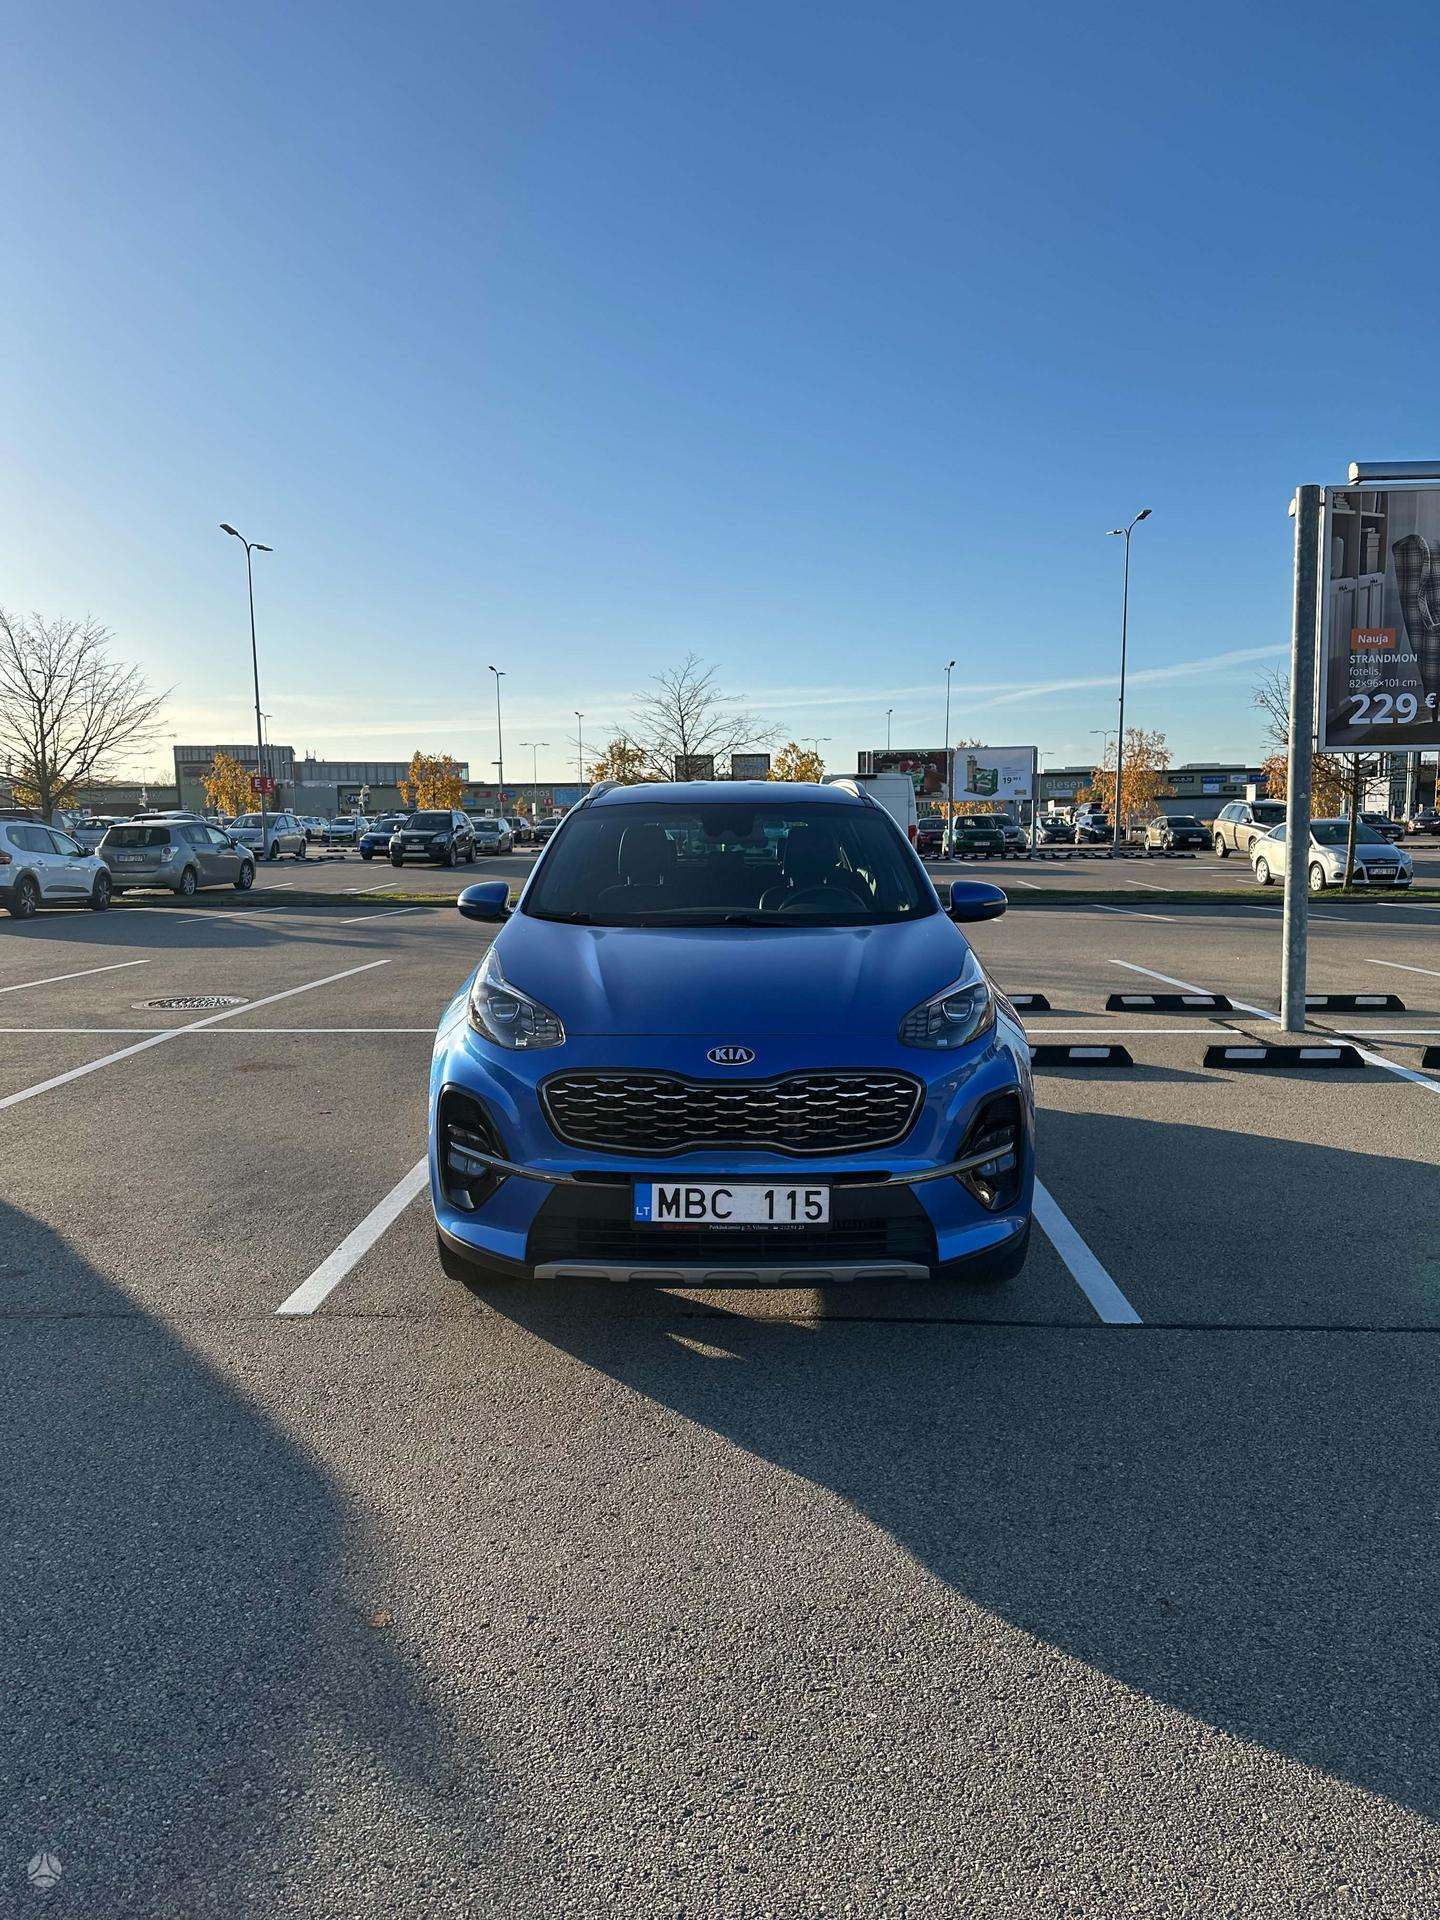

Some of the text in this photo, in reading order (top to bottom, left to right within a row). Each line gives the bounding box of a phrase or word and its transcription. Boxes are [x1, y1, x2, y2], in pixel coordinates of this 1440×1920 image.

[1357, 633, 1389, 645] Nauja
[1349, 653, 1418, 664] STRANDMON
[1349, 666, 1382, 677] fotelis,
[1402, 679, 1417, 687] cm
[1349, 692, 1437, 725] 229 €
[254, 778, 261, 788] E
[715, 1048, 748, 1060] KIA
[657, 1187, 823, 1220] MBC 115
[635, 1206, 650, 1216] LT
